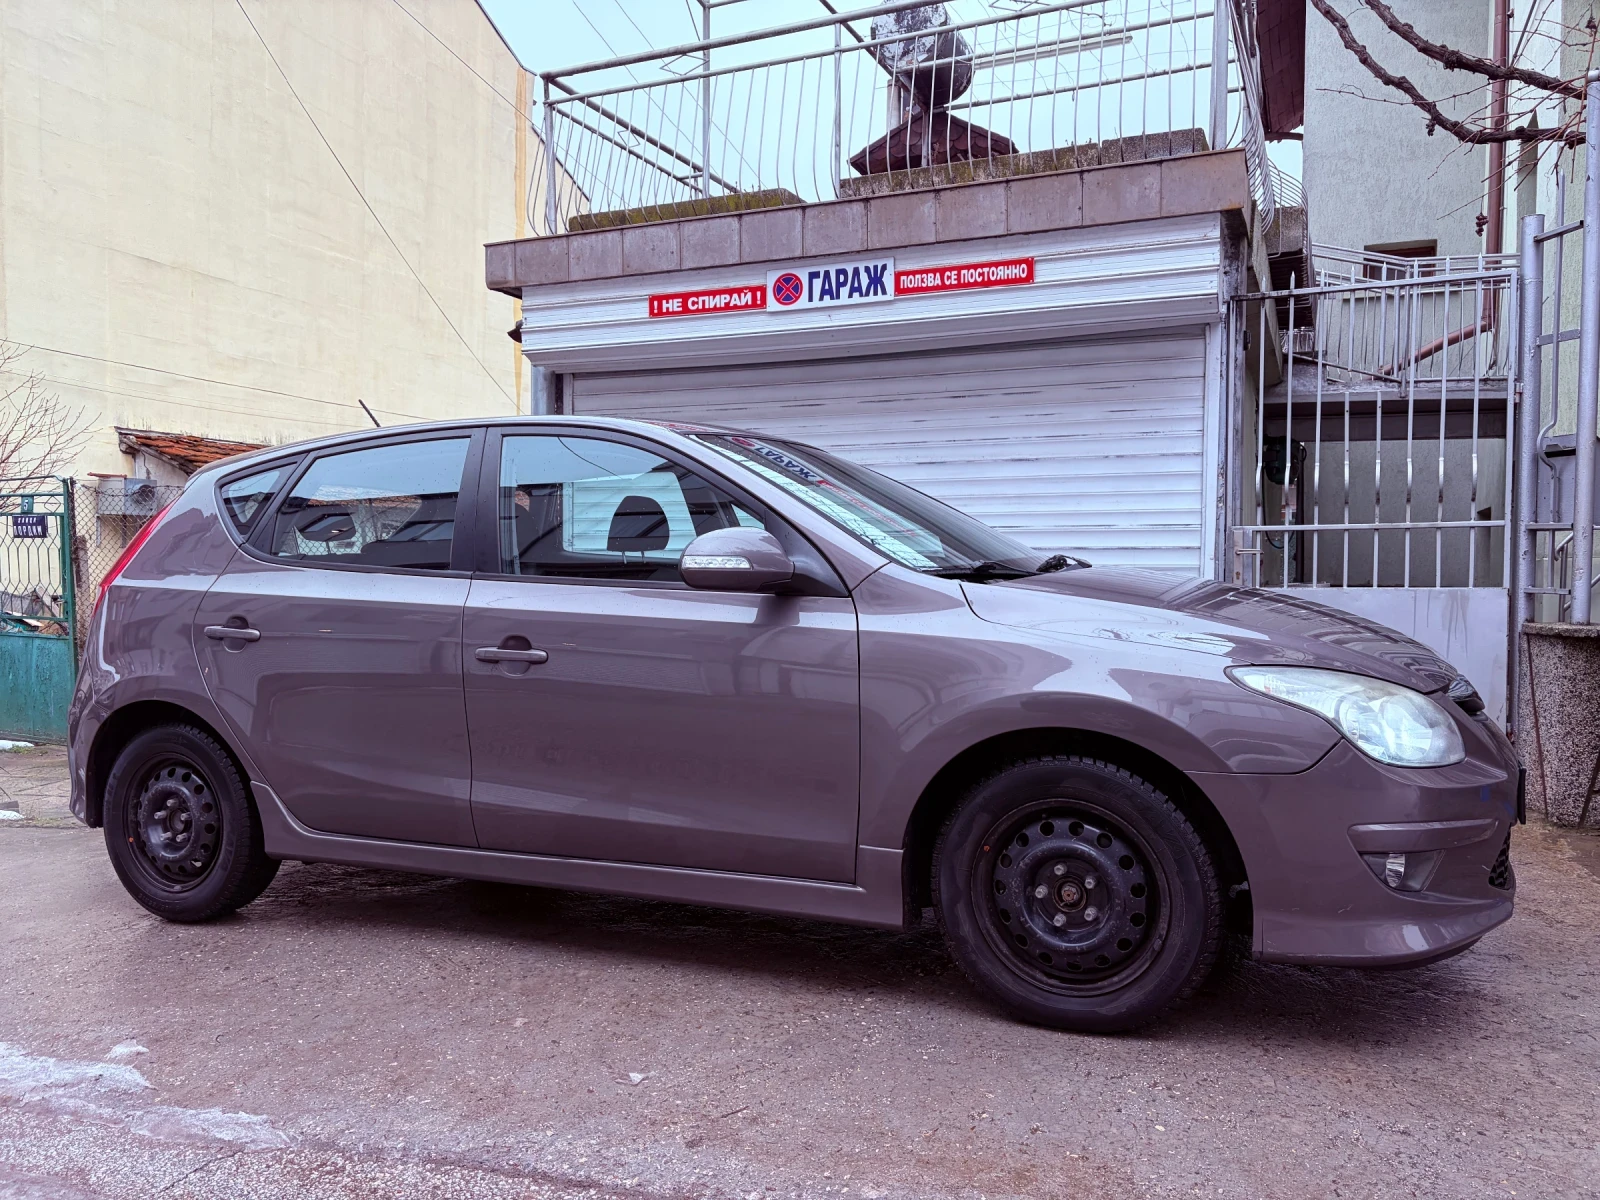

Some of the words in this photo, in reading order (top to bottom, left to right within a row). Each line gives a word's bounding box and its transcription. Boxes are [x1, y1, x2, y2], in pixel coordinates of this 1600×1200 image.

[808, 263, 888, 303] ГАРАЖ
[900, 272, 942, 289] ПОЛЗВА
[944, 270, 958, 285] СЕ
[960, 263, 1028, 284] ПОСТОЯННО
[653, 300, 658, 314] !
[662, 298, 683, 313] НЕ
[687, 289, 752, 310] СПИРАЙ
[756, 290, 761, 305] !
